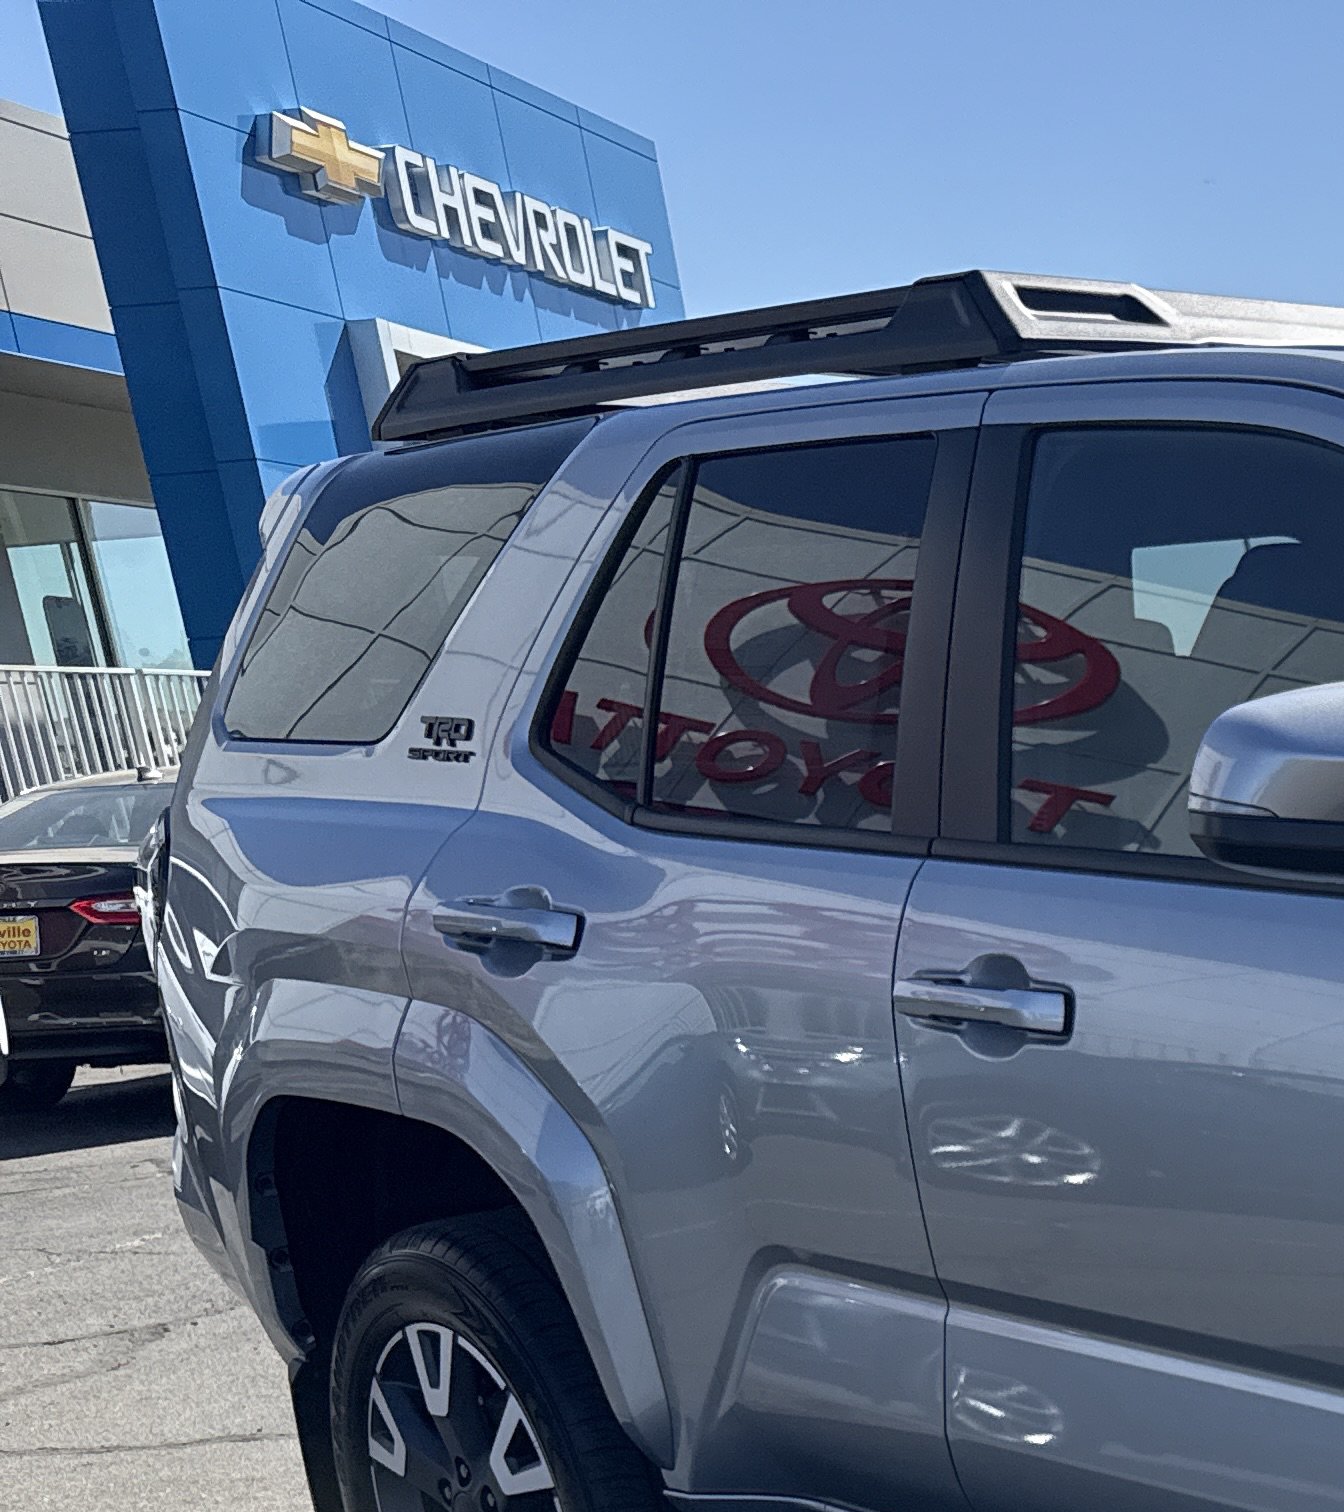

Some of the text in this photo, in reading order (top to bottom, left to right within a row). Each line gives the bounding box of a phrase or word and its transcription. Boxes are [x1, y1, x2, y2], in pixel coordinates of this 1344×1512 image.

[391, 145, 656, 308] CHEVROLET
[420, 715, 476, 748] TRD
[407, 747, 477, 764] SPORT
[0, 939, 32, 950] YOTA
